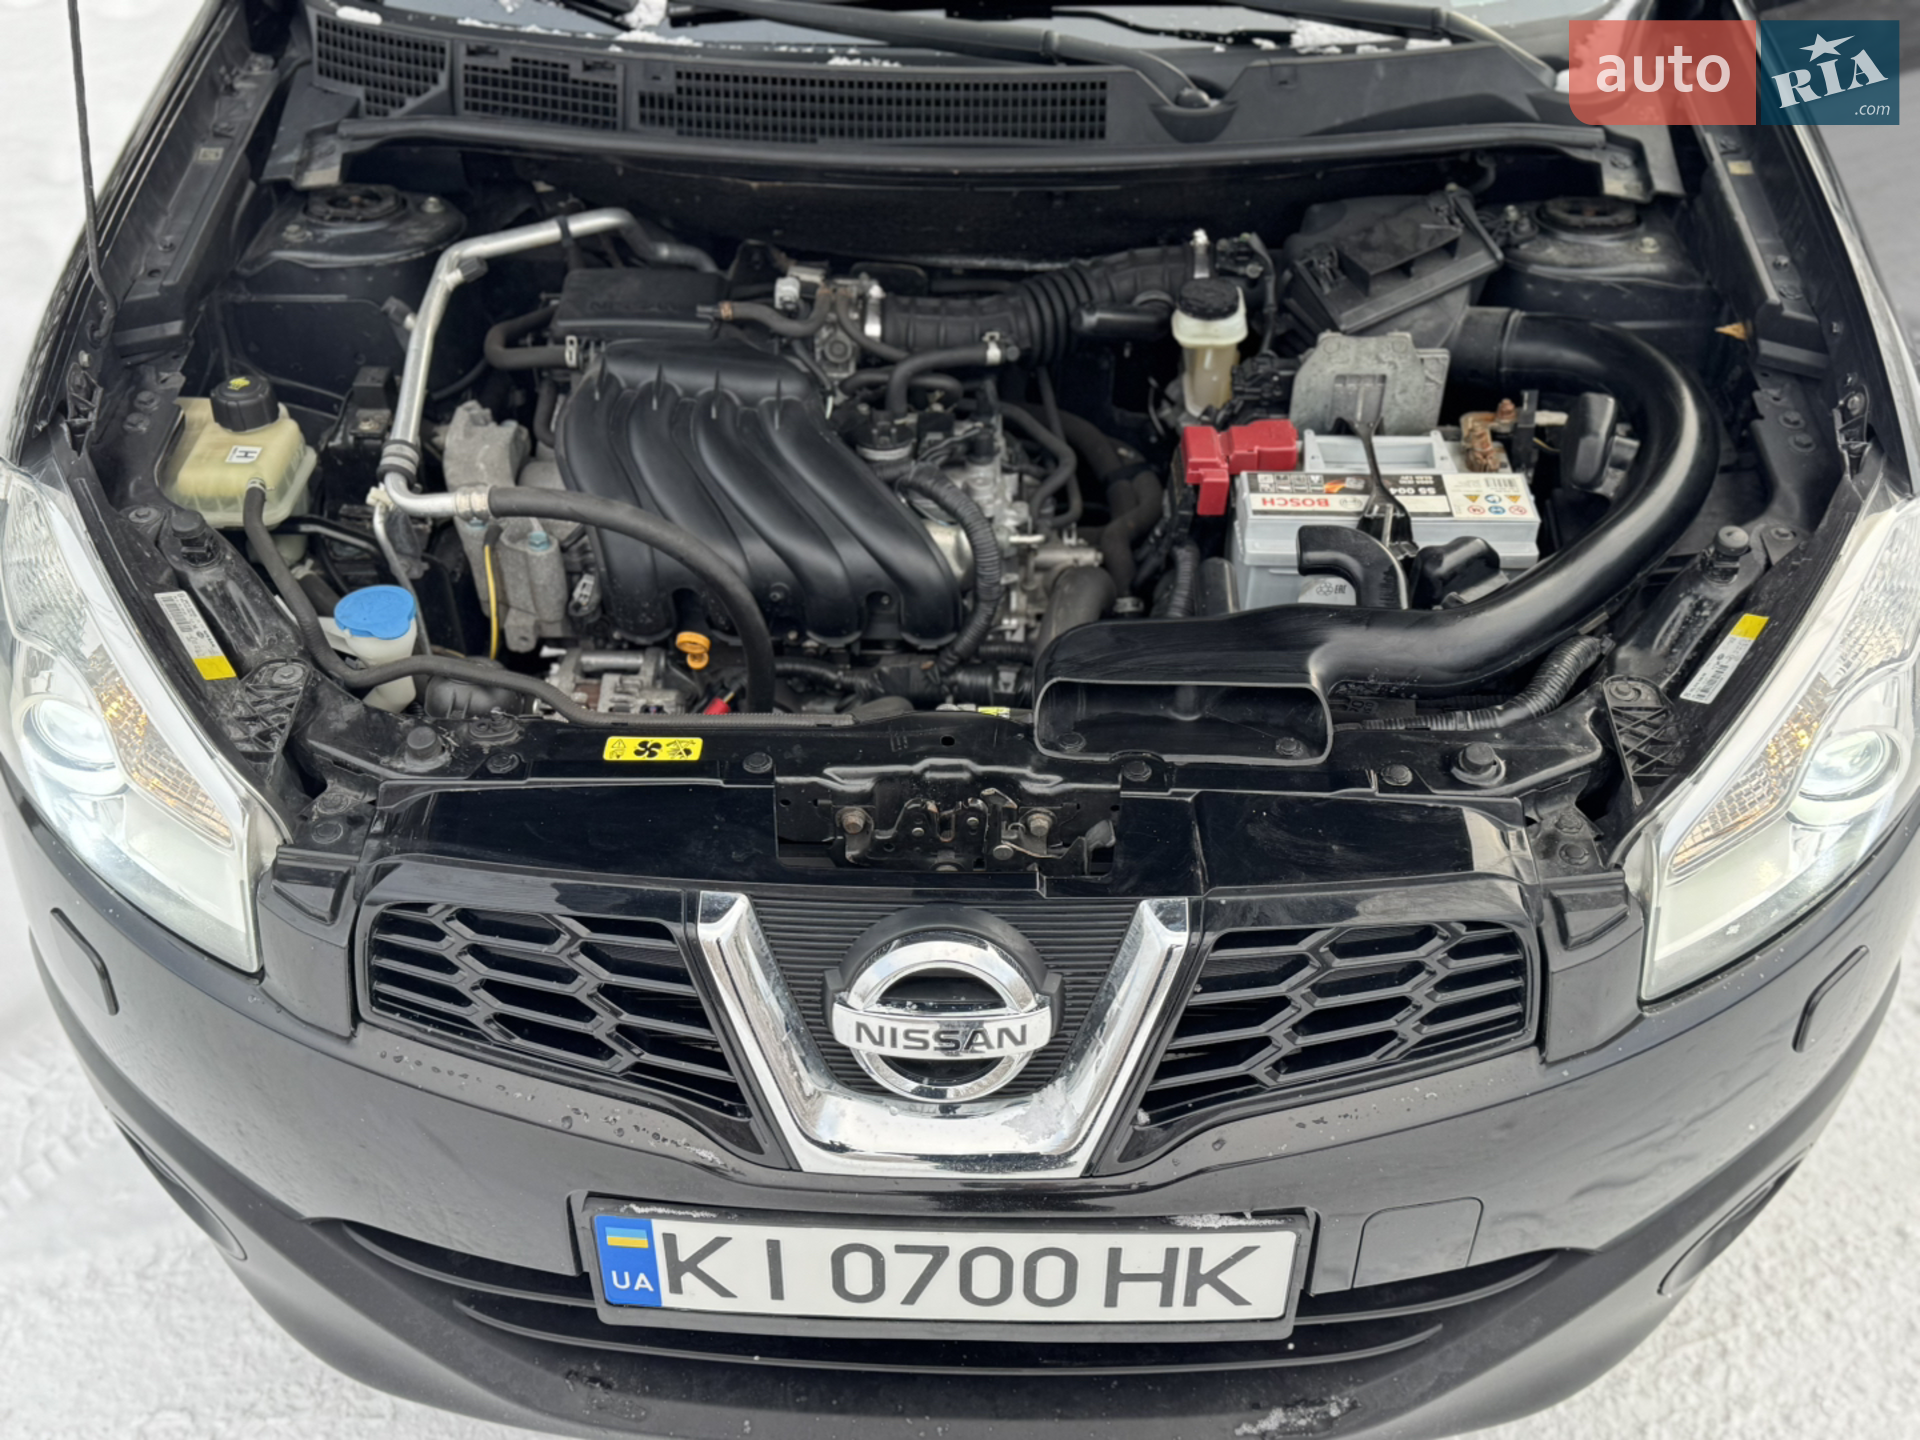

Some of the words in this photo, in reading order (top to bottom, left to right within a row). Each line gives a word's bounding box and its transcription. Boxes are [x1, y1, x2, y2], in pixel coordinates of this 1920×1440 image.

[1261, 497, 1329, 507] BOSCH
[855, 1021, 1027, 1051] NISSAN
[611, 1270, 654, 1292] UA
[830, 1242, 1079, 1308] 0700
[1104, 1245, 1262, 1308] HK
